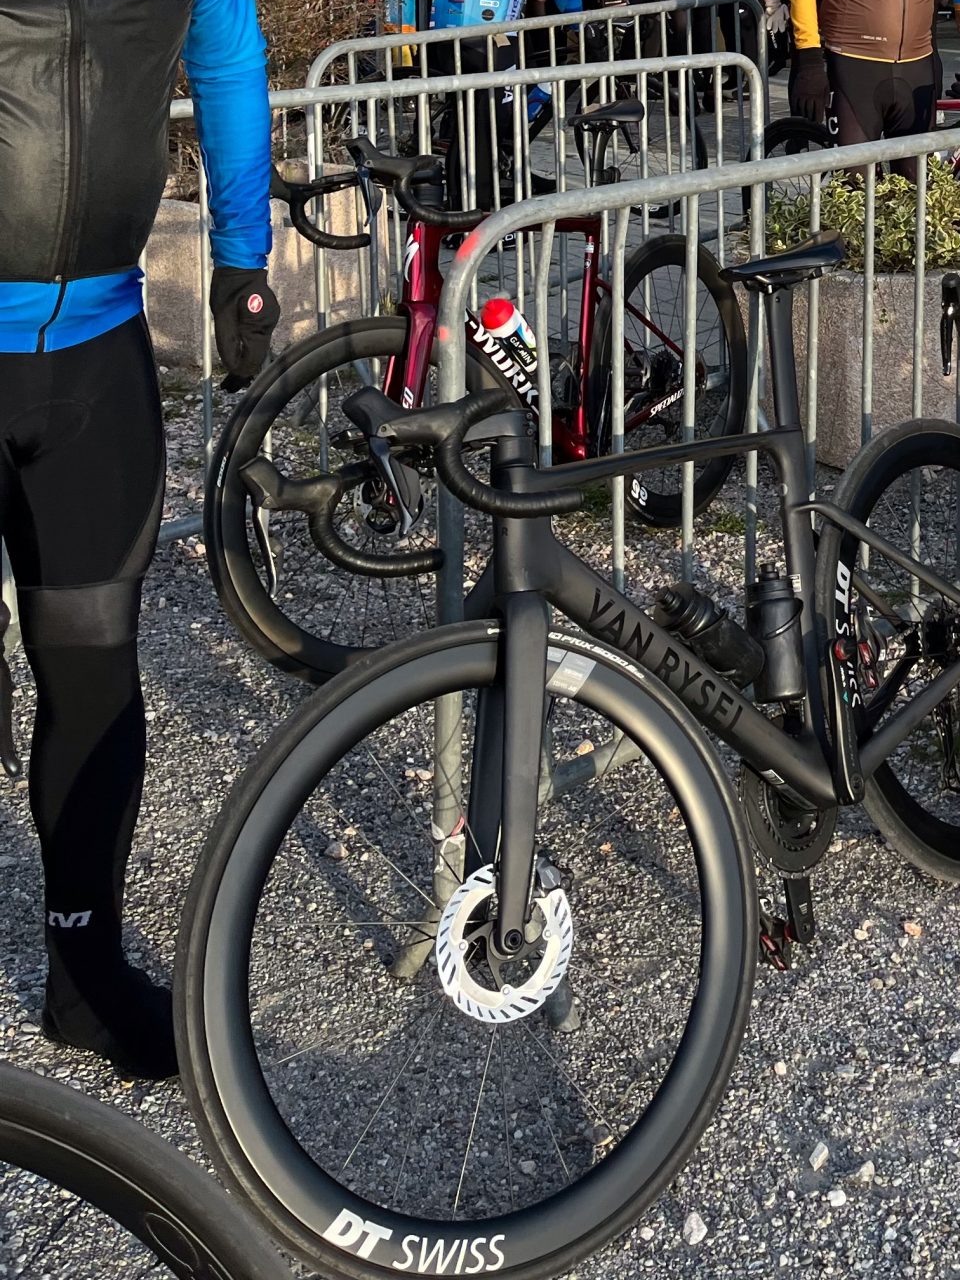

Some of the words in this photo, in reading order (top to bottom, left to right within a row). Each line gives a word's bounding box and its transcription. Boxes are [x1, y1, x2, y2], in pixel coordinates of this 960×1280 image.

[465, 311, 540, 417] -WORK
[835, 560, 851, 614] DT
[588, 588, 654, 661] VAN
[655, 646, 743, 732] RYSEL
[322, 1208, 393, 1259] DT
[392, 1234, 505, 1274] SWISS
